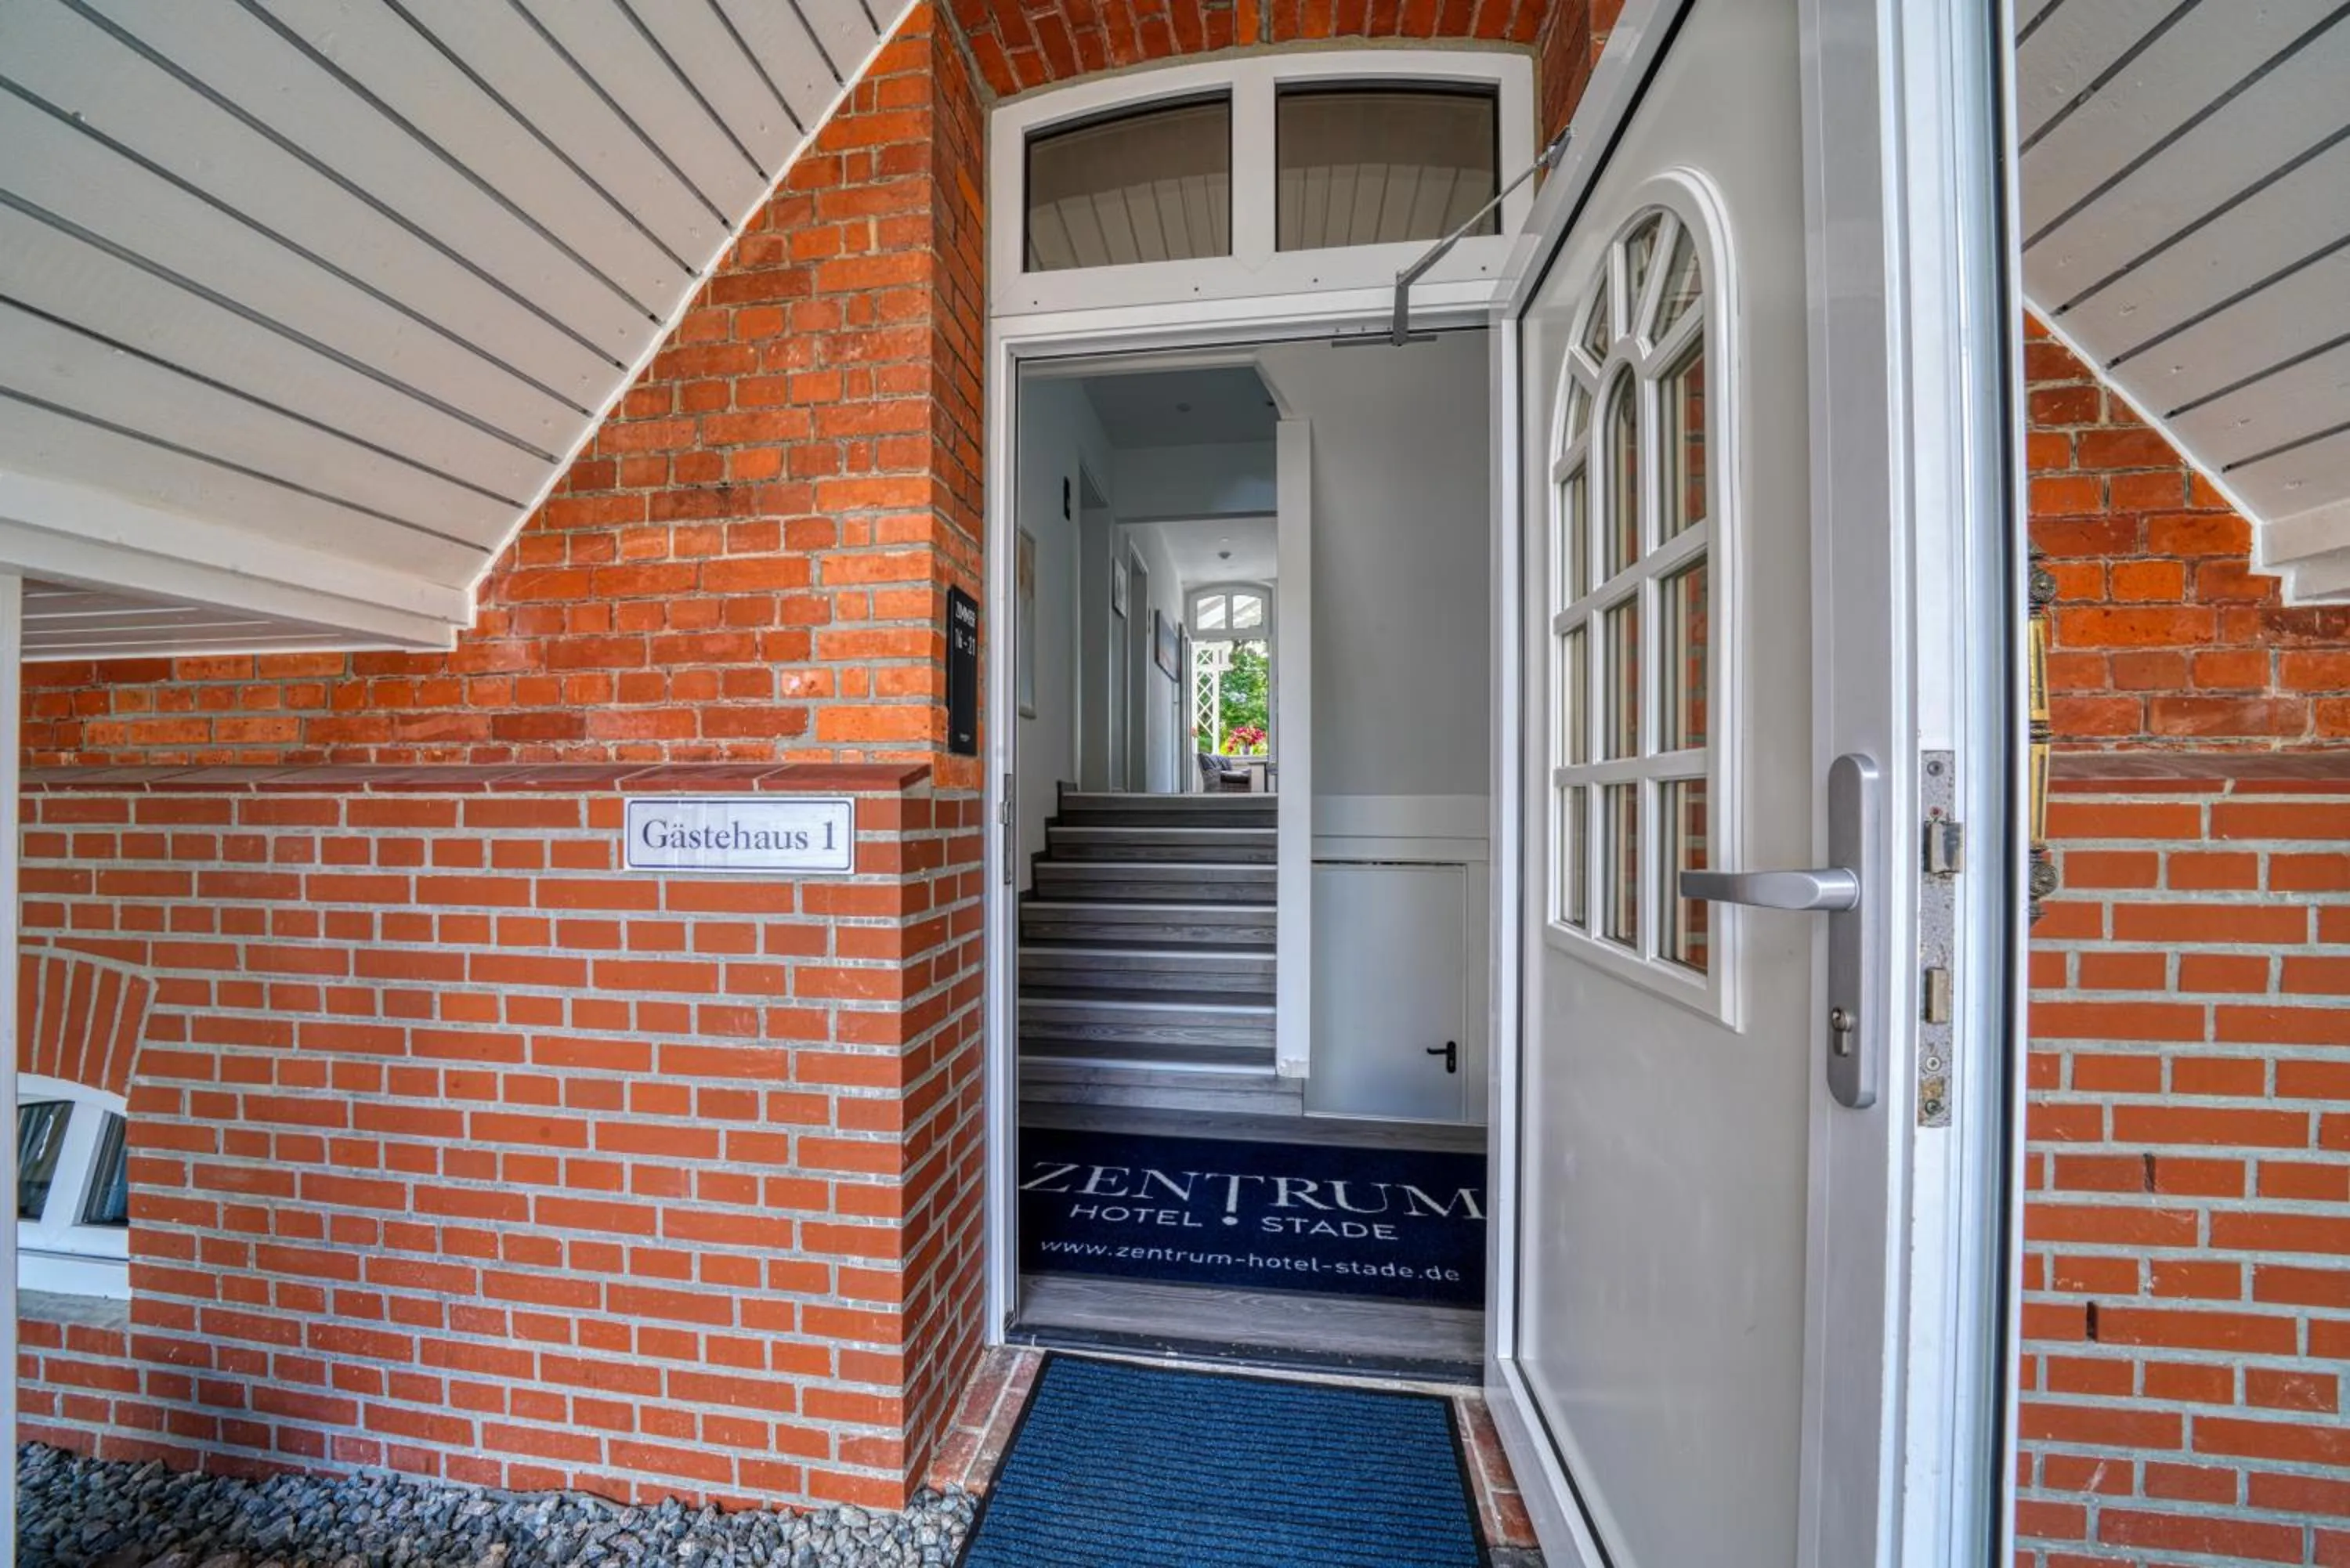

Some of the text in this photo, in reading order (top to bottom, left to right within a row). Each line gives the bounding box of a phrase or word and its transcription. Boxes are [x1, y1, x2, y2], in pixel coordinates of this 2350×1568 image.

[642, 820, 837, 851] Gästehaus 1
[1018, 1162, 1488, 1225] ZENTRUM
[1069, 1204, 1398, 1241] HOTEL STADE
[1040, 1241, 1460, 1281] www.zentrum-hotel-stade.de
